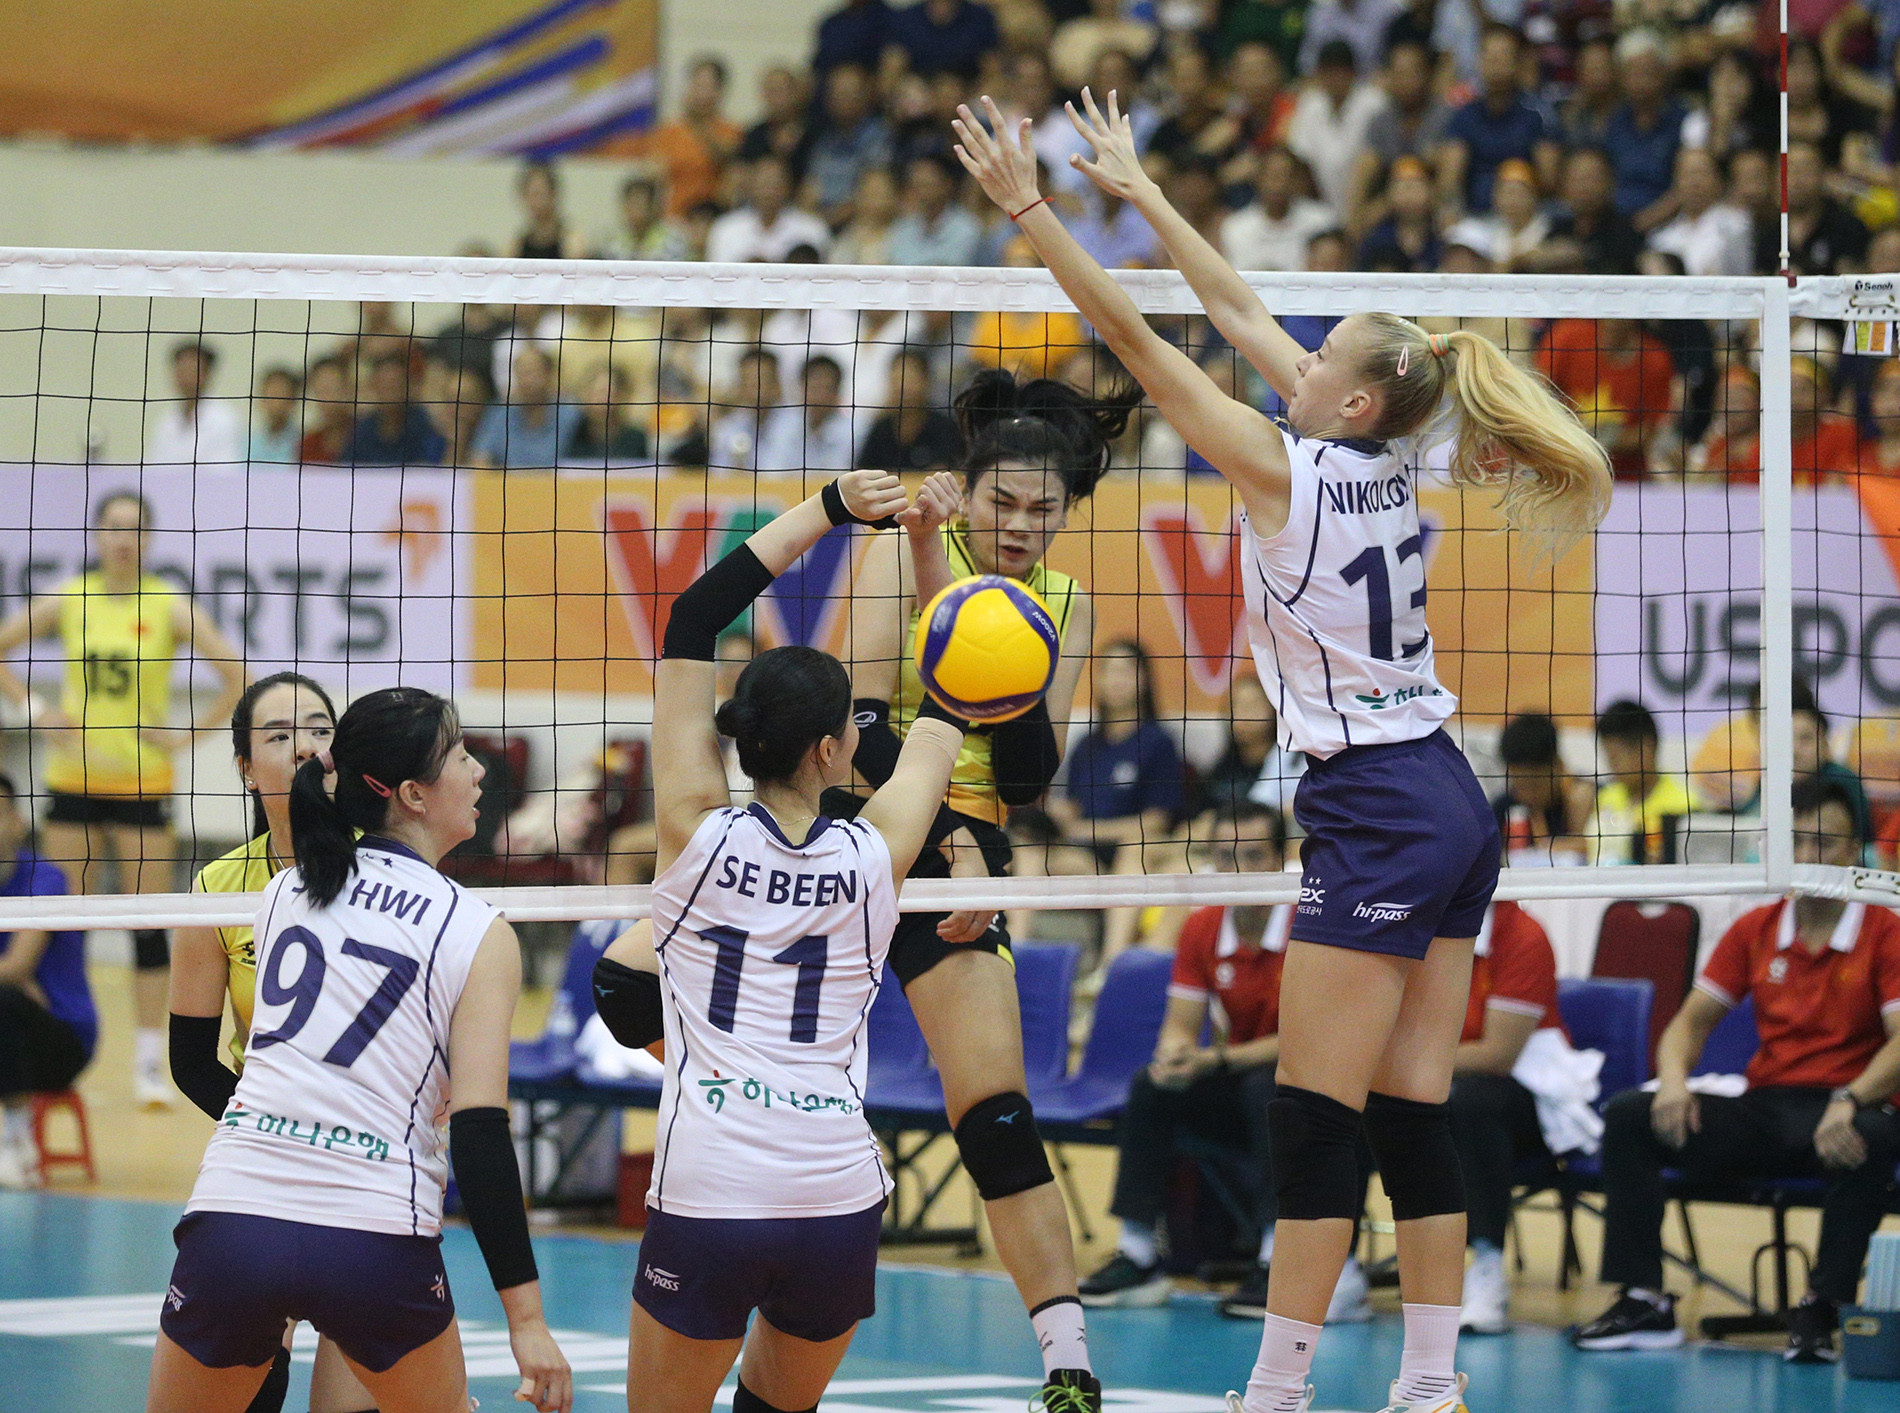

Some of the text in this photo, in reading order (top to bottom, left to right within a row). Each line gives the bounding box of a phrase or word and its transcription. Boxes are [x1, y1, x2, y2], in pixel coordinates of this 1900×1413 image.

[1339, 534, 1428, 661] 13
[86, 650, 131, 696] 15
[348, 879, 432, 926] HWI
[716, 855, 856, 907] SE BEEN
[1352, 901, 1412, 922] hi-pass
[252, 925, 420, 1068] 97
[695, 925, 828, 1043] 11
[256, 1114, 390, 1161] 하나은행
[644, 1263, 680, 1292] hi-pass
